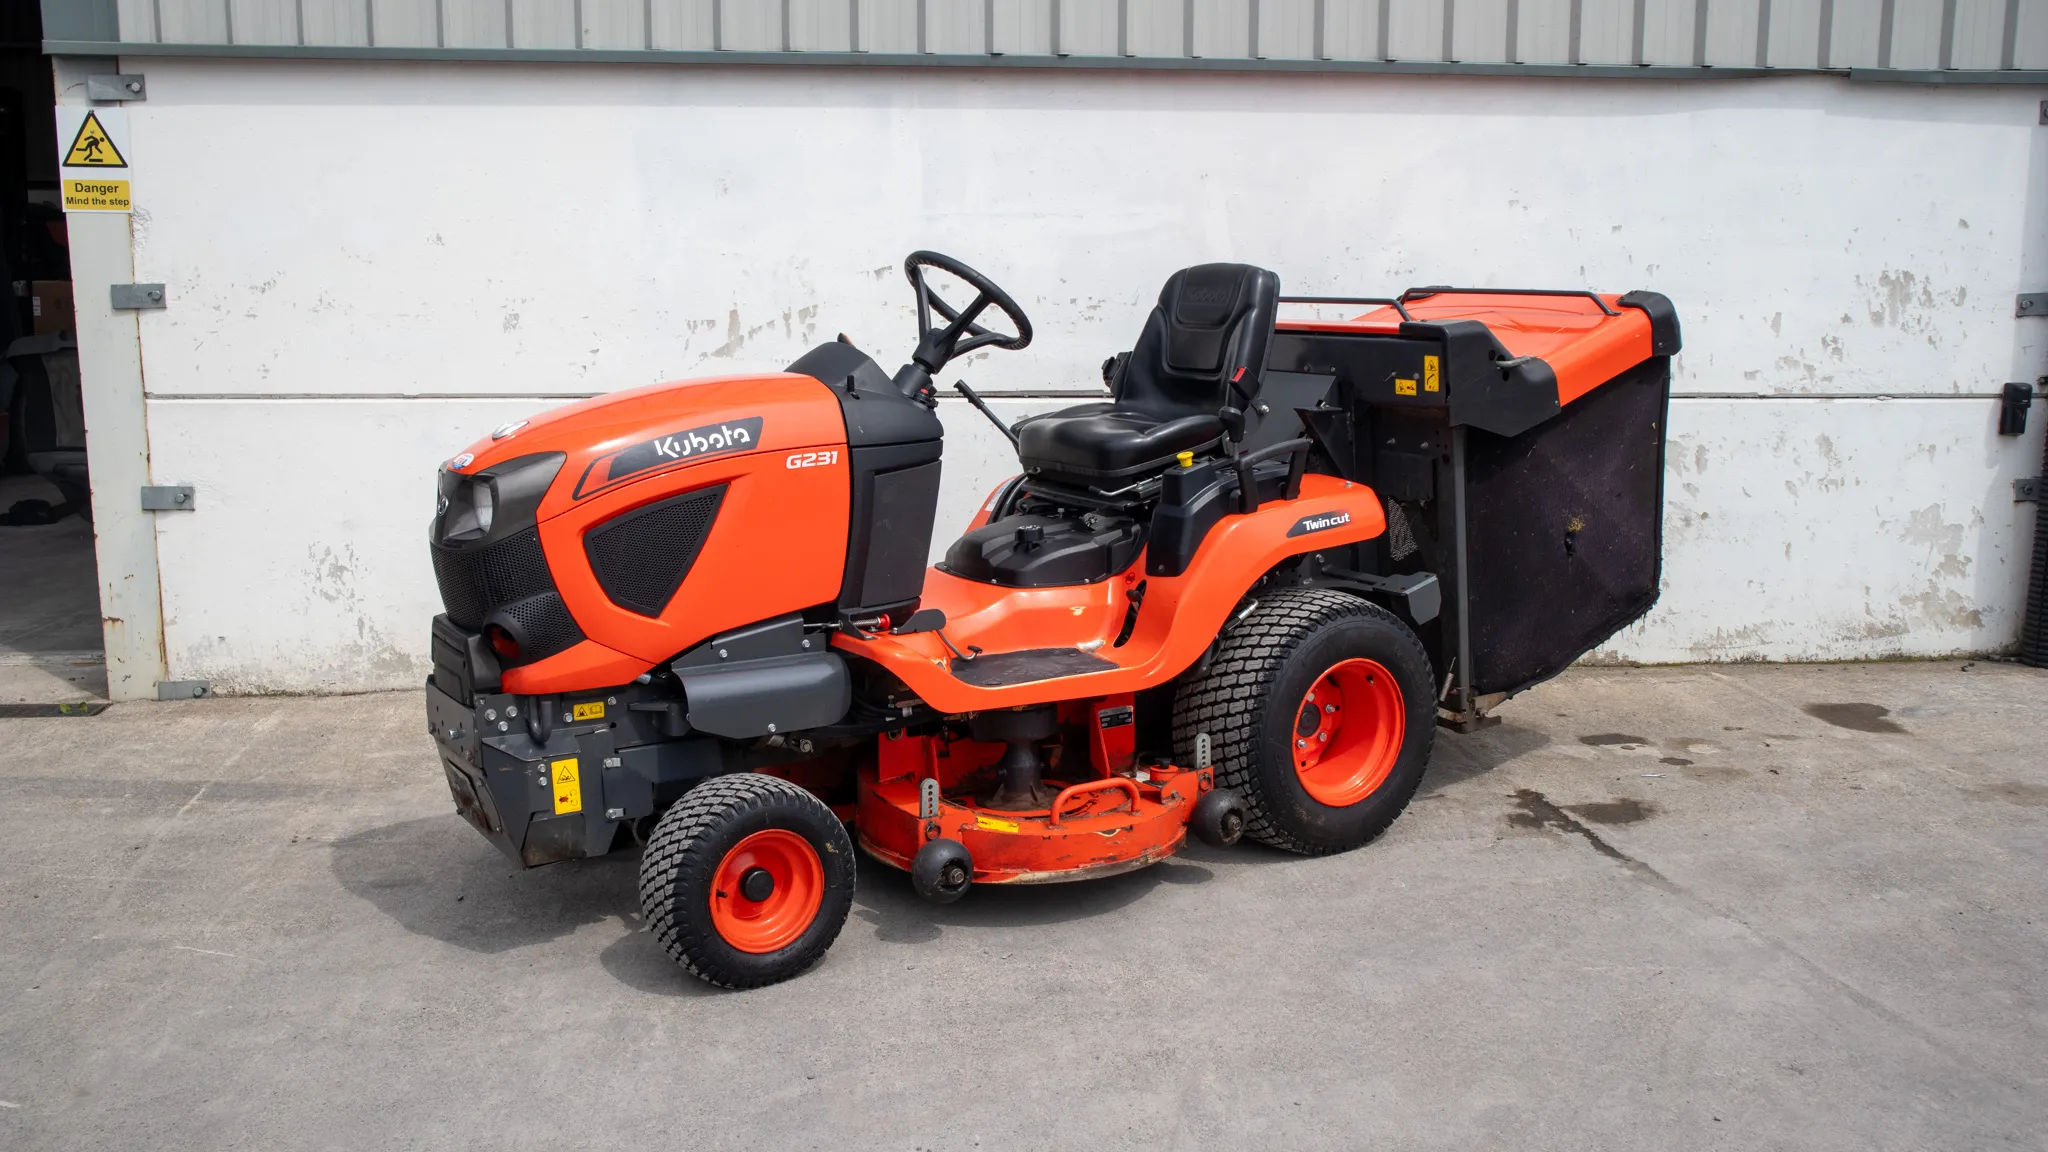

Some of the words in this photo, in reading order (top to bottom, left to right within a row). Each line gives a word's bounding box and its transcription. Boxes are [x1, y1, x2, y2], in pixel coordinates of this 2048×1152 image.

[75, 183, 119, 195] Danger
[66, 197, 89, 205] Mind
[92, 197, 107, 205] the
[110, 198, 130, 207] step
[653, 424, 750, 457] Kubota
[785, 450, 839, 470] G231
